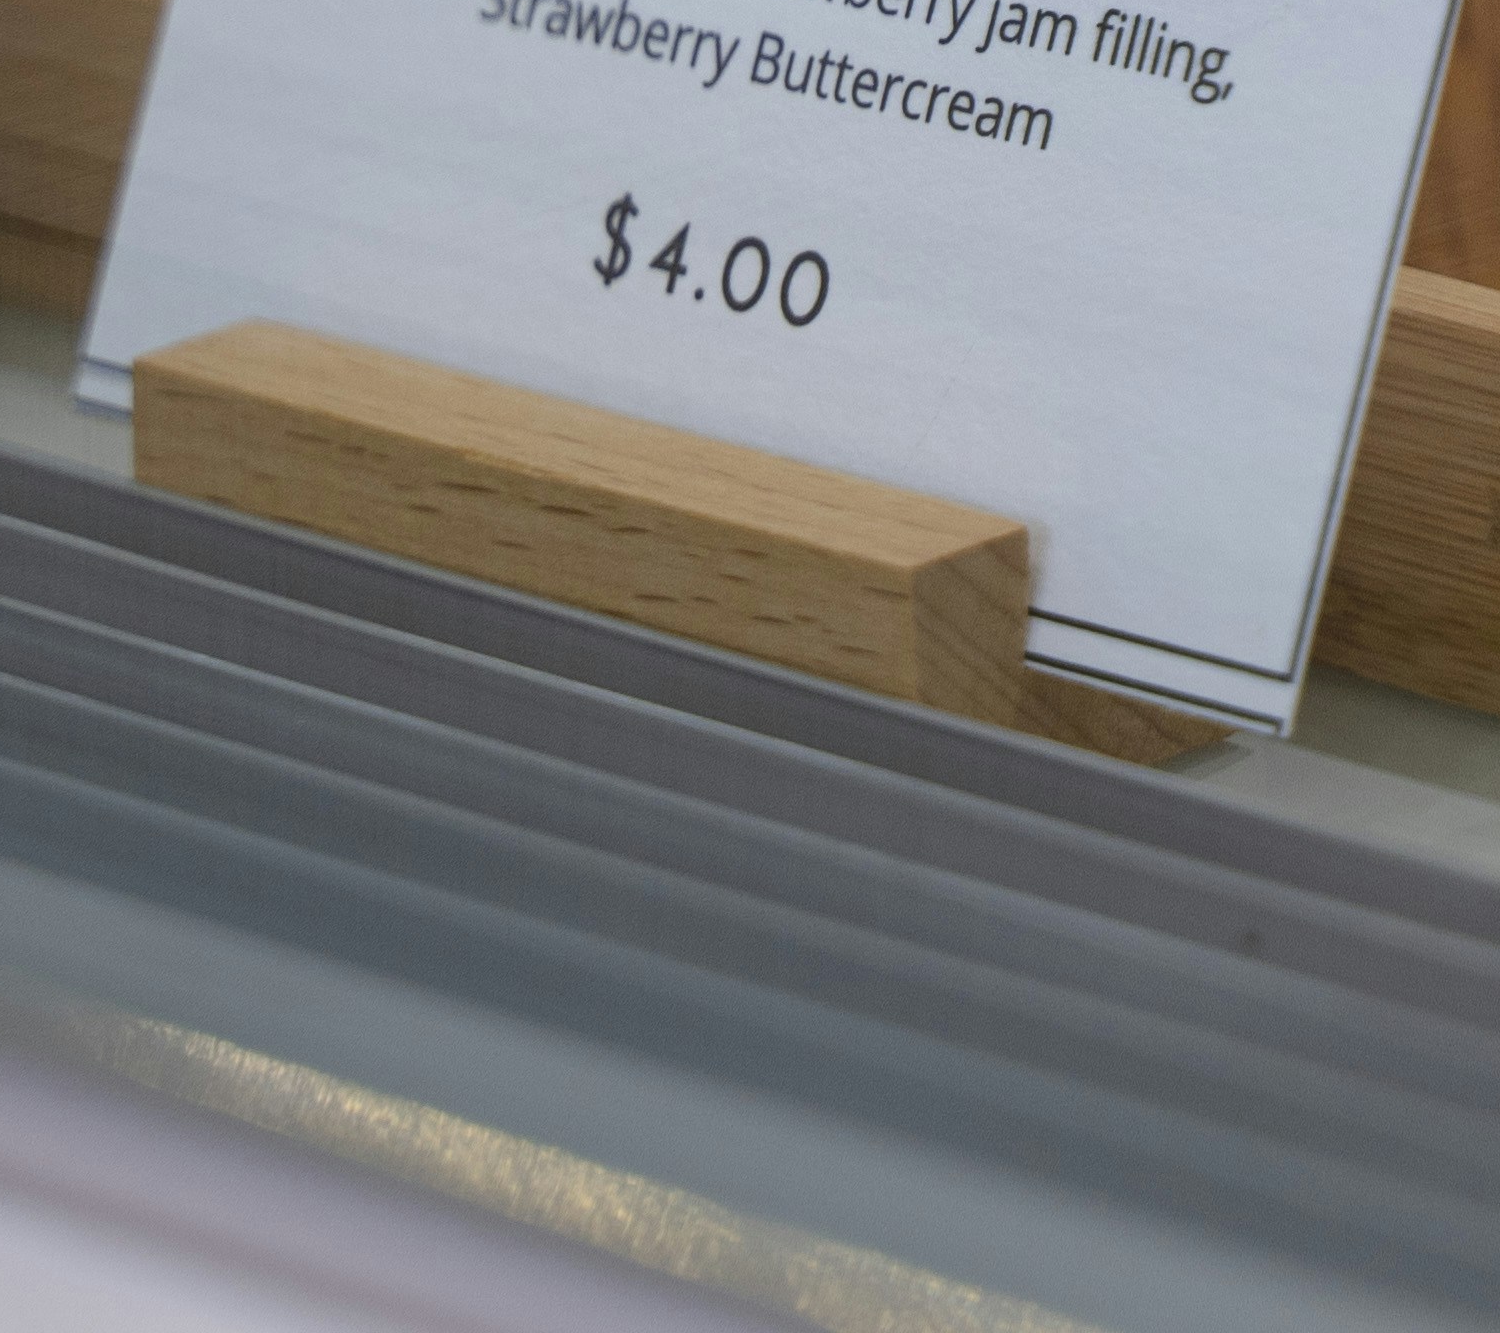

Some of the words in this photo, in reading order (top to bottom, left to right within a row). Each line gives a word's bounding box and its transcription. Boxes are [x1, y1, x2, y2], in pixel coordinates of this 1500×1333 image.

[751, 33, 1054, 151] Buttercream
[1093, 9, 1235, 104] filling,
[591, 193, 831, 329] $4.00
